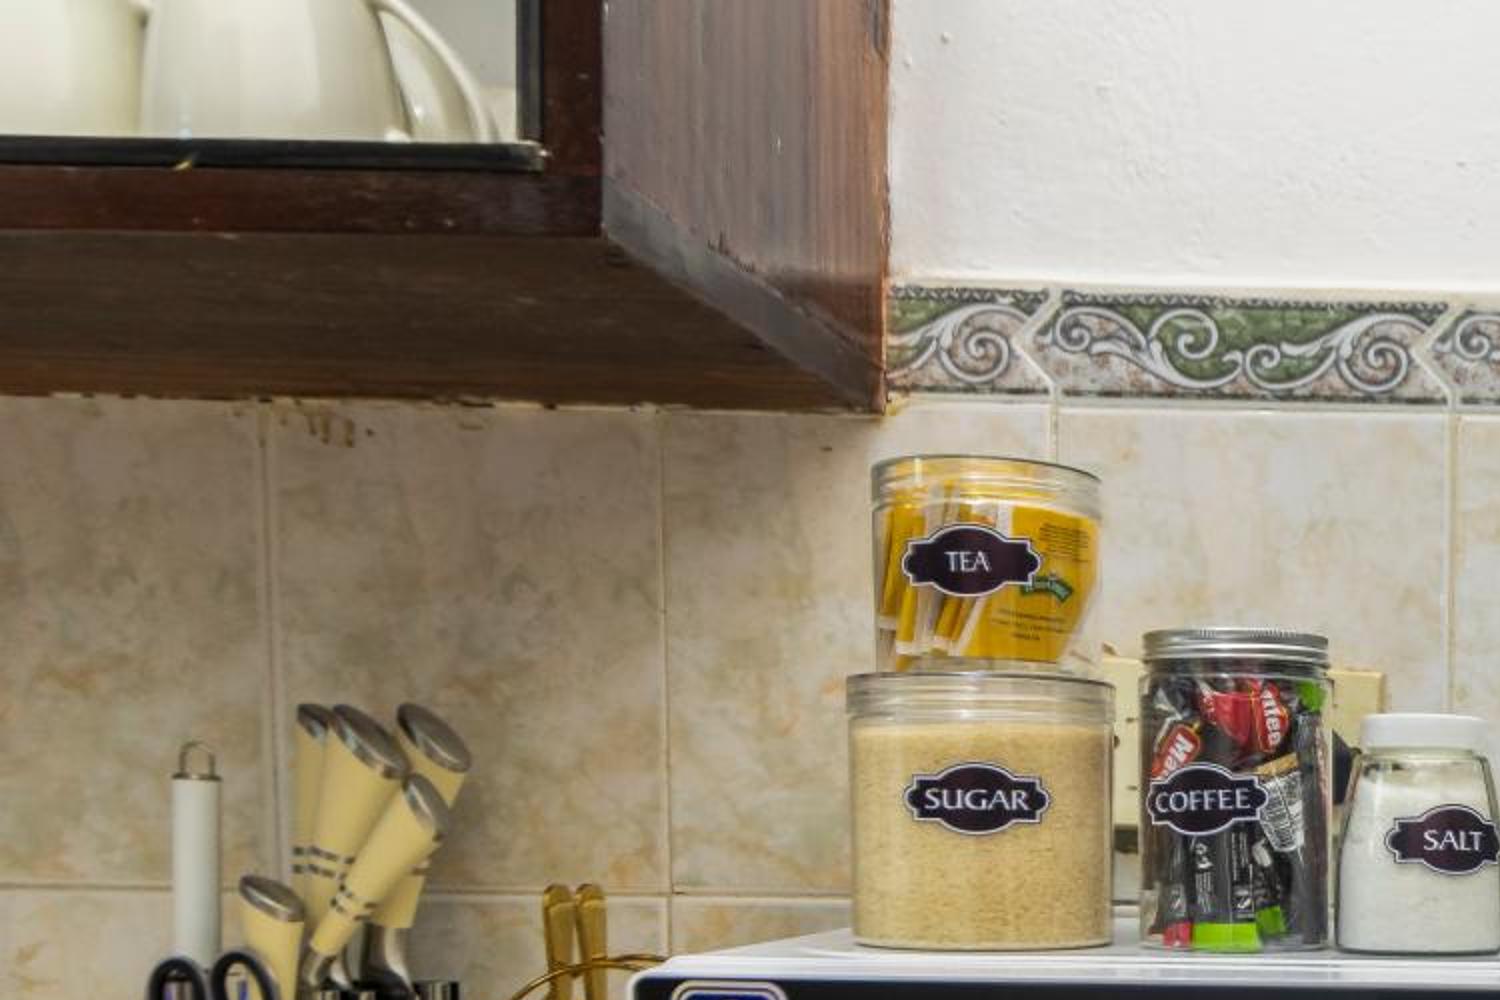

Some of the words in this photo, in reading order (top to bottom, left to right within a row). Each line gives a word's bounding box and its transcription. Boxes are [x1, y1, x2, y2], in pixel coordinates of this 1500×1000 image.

[944, 551, 991, 573] TEA
[924, 788, 1030, 811] SUGAR
[1155, 787, 1253, 813] COFFEE
[1423, 829, 1485, 852] SALT
